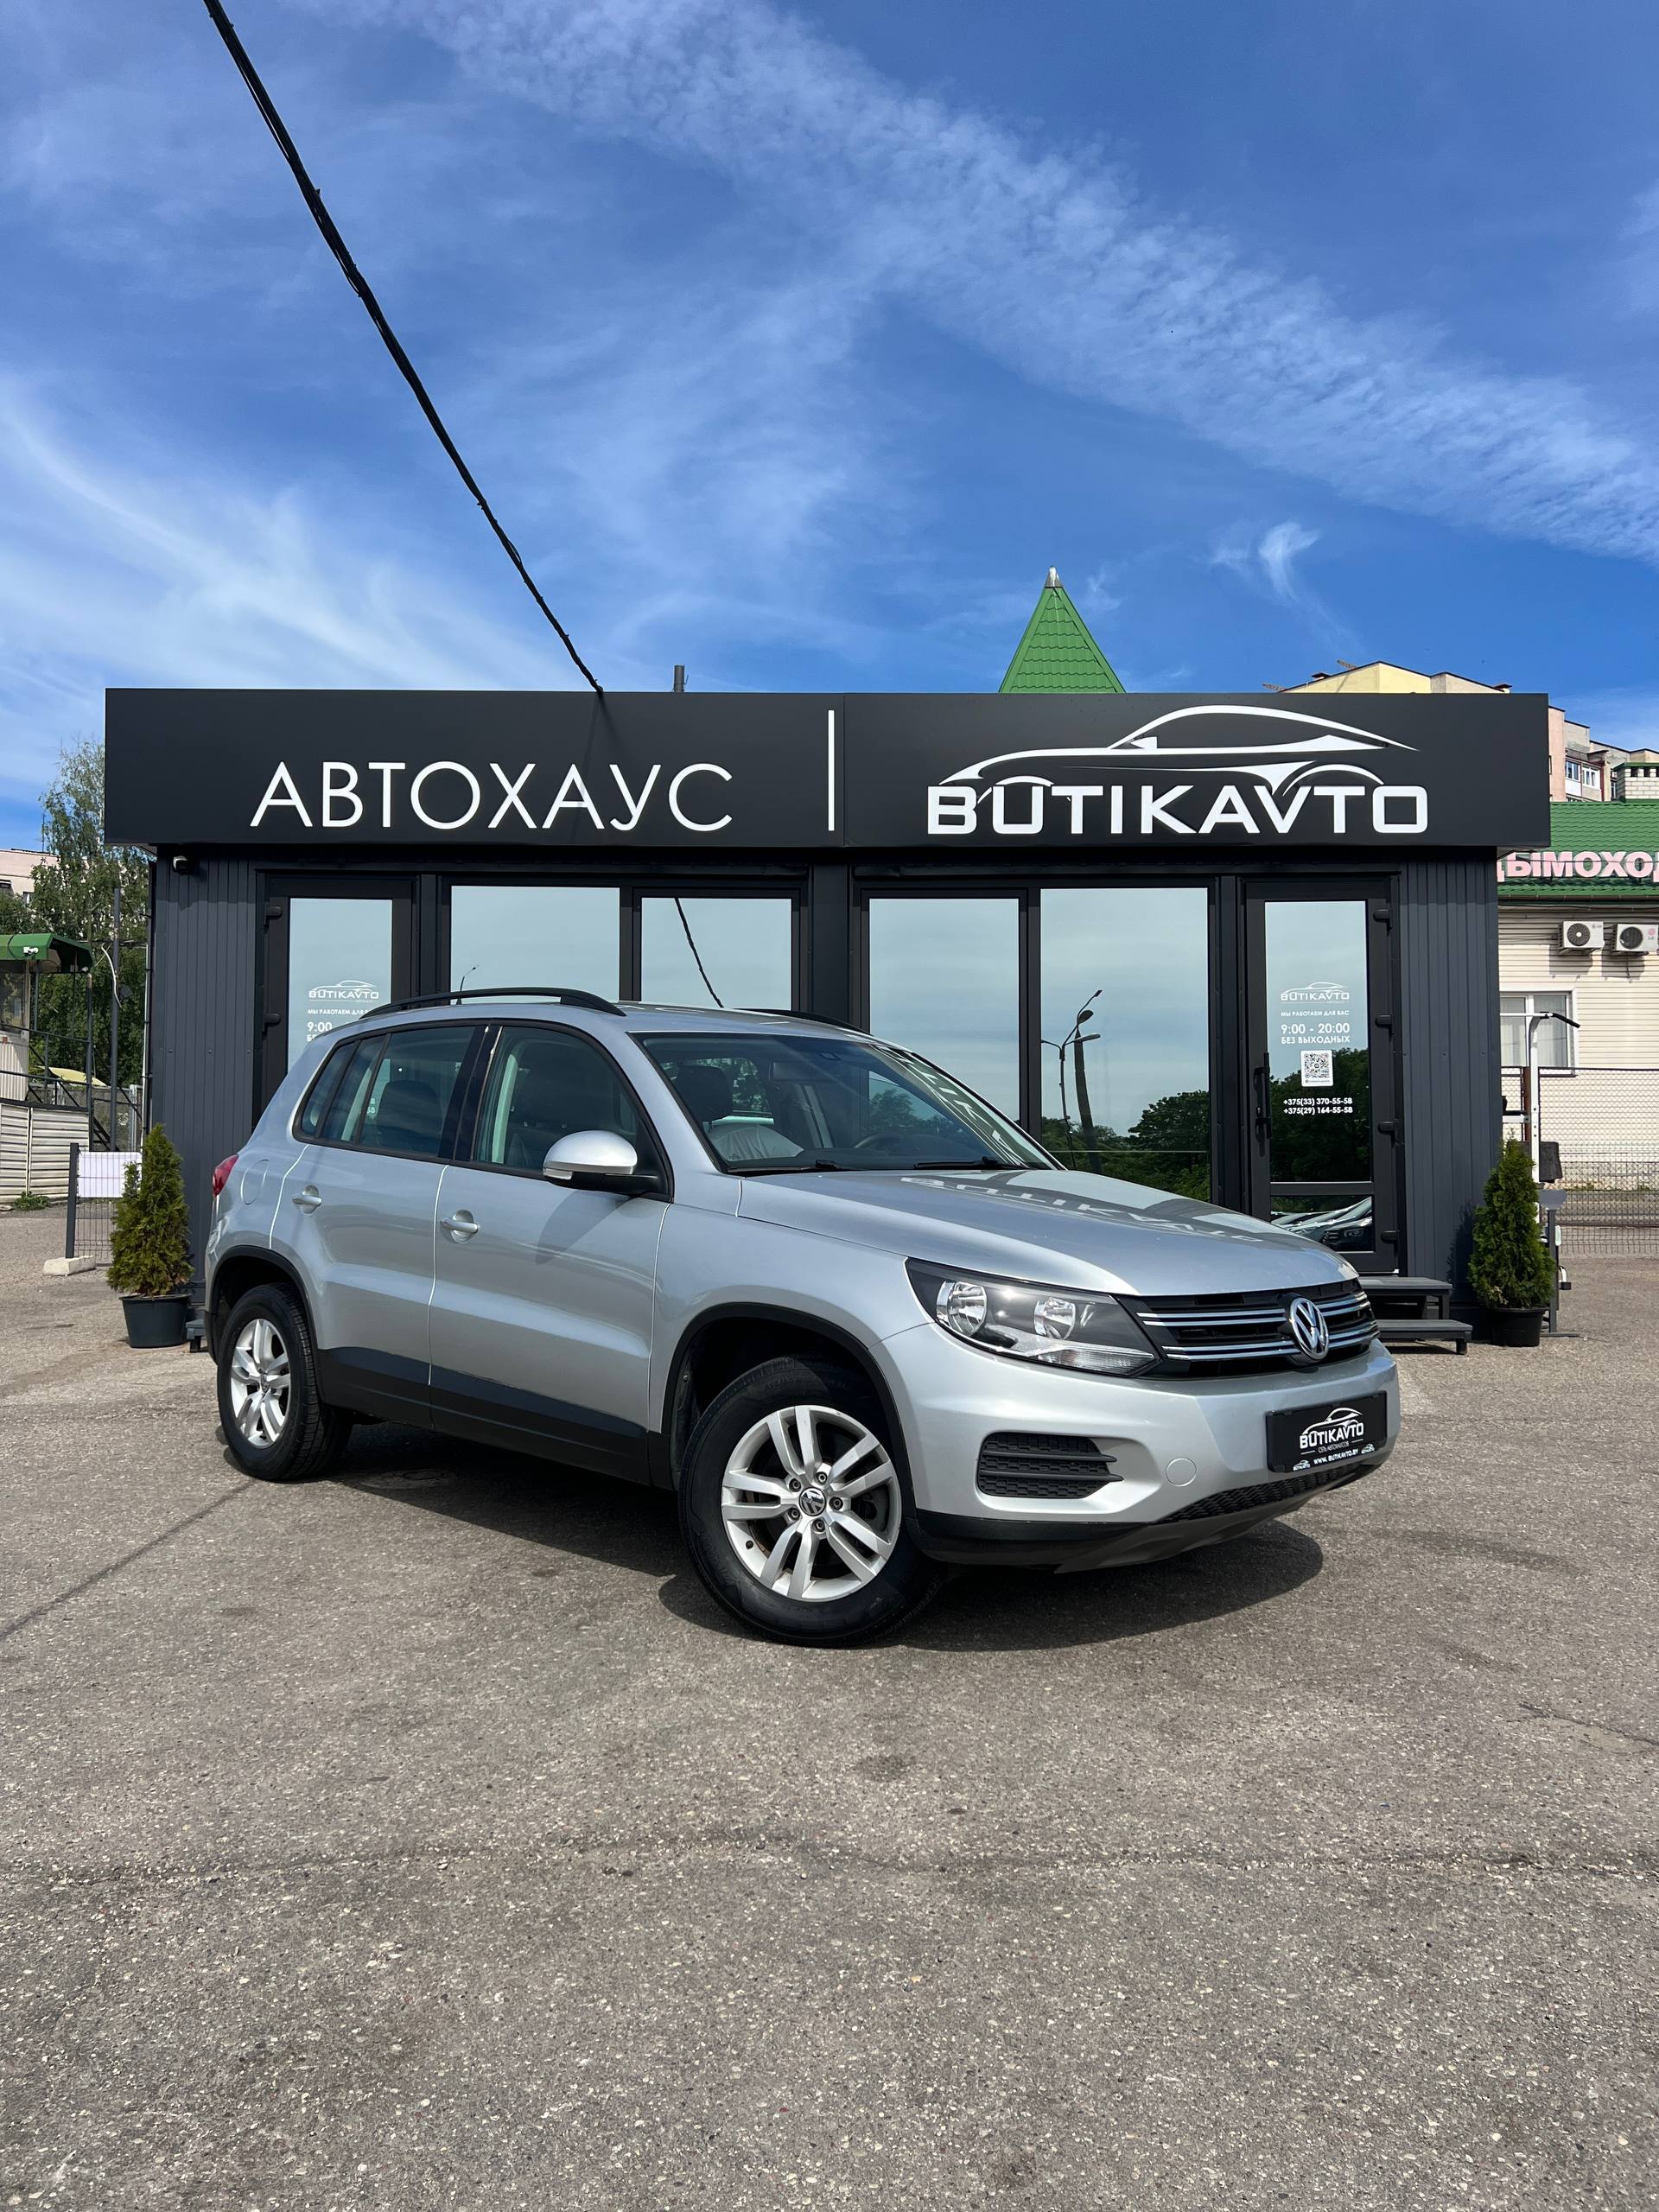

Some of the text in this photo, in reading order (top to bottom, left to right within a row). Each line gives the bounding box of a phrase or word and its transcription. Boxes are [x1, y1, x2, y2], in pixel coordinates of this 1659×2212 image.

[251, 761, 733, 831] АВТОХАУС
[928, 782, 1429, 835] BUTIKAVTO
[1497, 851, 1659, 883] ЫМОХО
[308, 990, 379, 999] BUTIKAVTO
[1281, 1024, 1306, 1034] 9:00
[1318, 1023, 1350, 1033] 20:00
[1283, 1098, 1315, 1107] +375(33)
[1283, 1107, 1316, 1116] +375(29)
[1300, 1423, 1364, 1449] BUTIKAVTO
